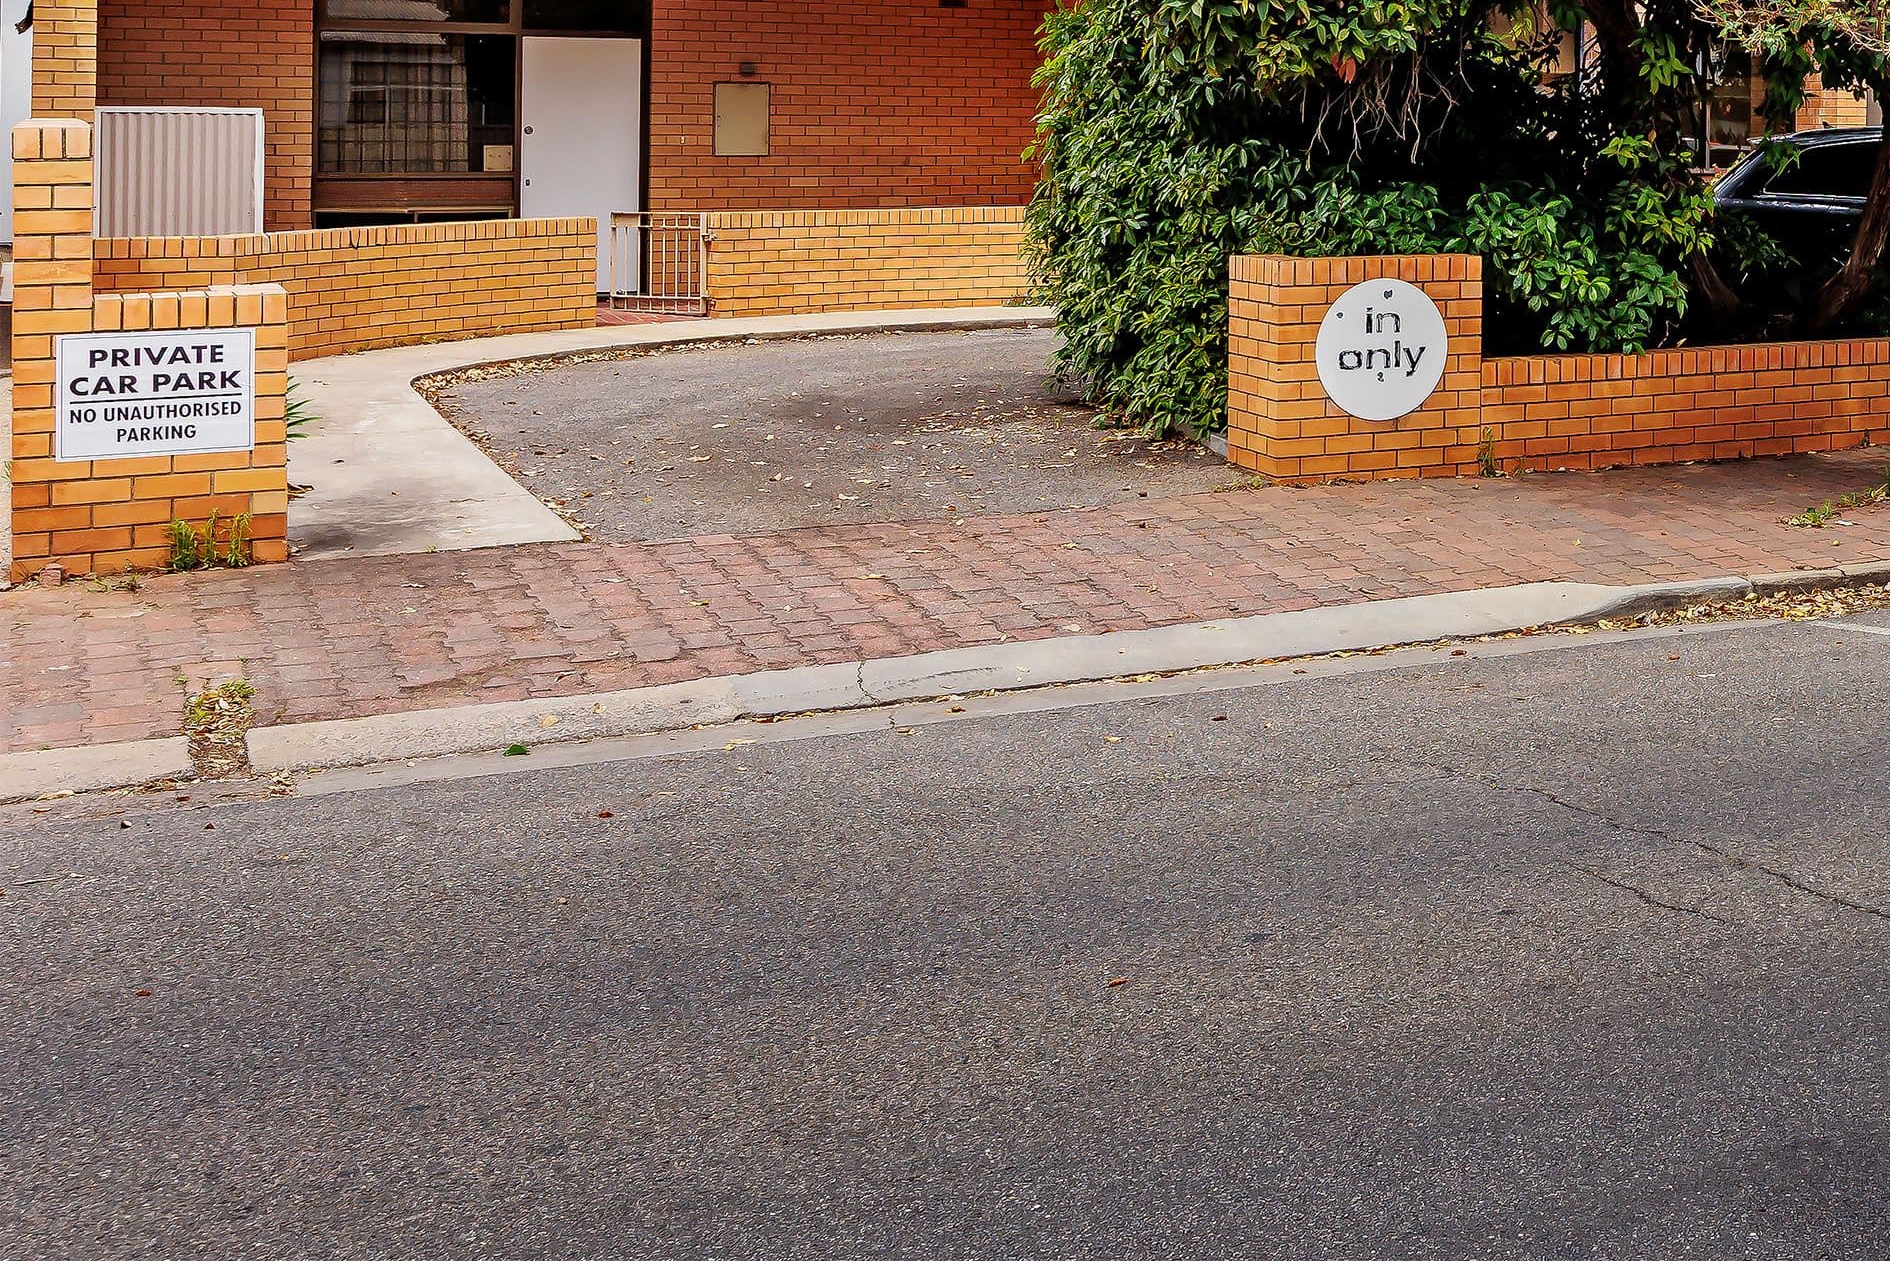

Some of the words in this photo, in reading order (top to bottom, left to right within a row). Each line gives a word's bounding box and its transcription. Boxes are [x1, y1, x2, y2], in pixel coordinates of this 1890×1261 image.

[1366, 307, 1400, 334] in
[89, 344, 224, 368] PRIVATE
[1338, 340, 1427, 378] only
[69, 375, 139, 396] CAR
[153, 369, 242, 392] PARK
[69, 408, 97, 424] NO
[103, 401, 242, 422] UNAUTHORISED
[116, 424, 197, 442] PARKING
